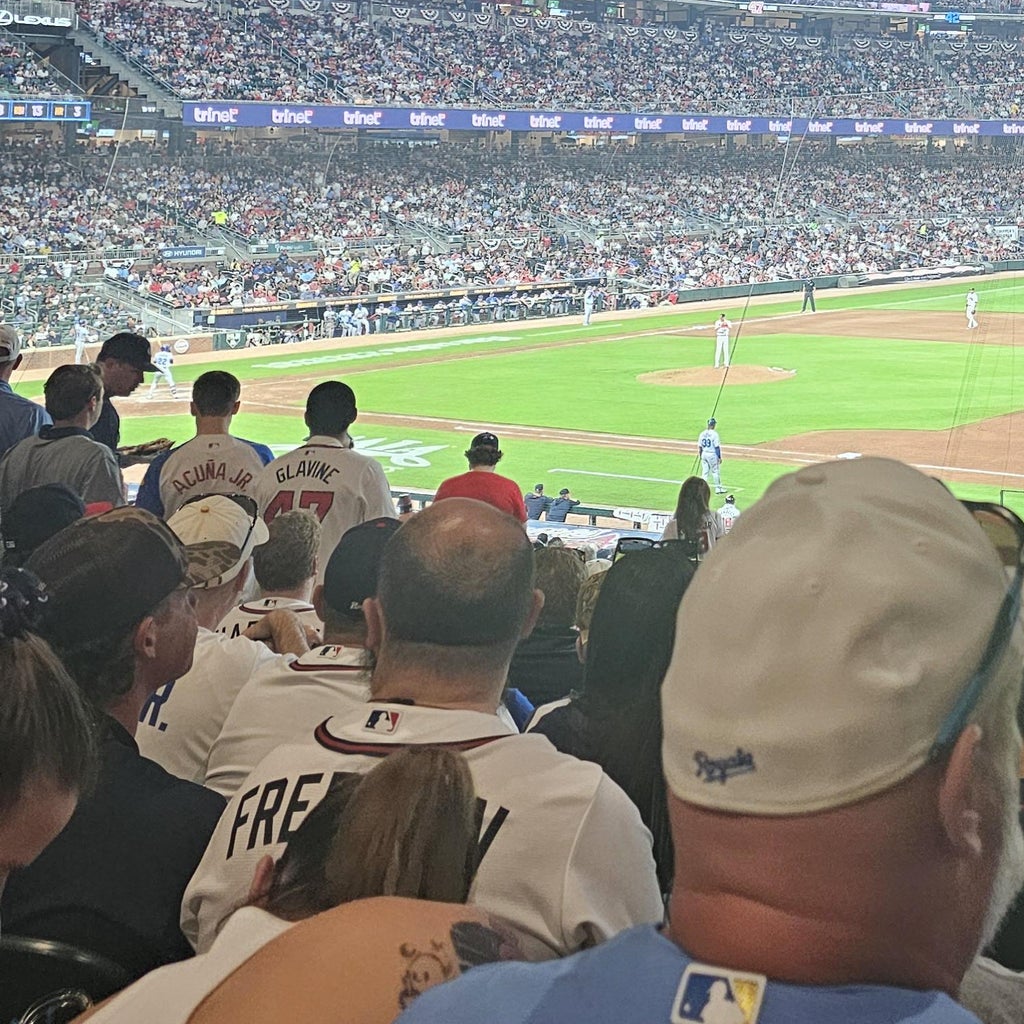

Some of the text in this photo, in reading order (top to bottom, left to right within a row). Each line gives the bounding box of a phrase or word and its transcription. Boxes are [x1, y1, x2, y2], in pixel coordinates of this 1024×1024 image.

[14, 15, 72, 27] LEXUS
[194, 107, 239, 123] trinet
[272, 108, 313, 124] trinet
[343, 110, 382, 126] trinet
[410, 112, 446, 127] trinet
[472, 114, 506, 128] trinet
[529, 115, 562, 128] trinet
[583, 116, 614, 129] trinet
[634, 117, 663, 130] trinet
[682, 119, 708, 131] trinet
[726, 119, 751, 131] trinet
[808, 121, 833, 132] trinet
[854, 121, 884, 133] trinet
[904, 122, 933, 133] trinet
[953, 123, 980, 134] trinet
[171, 459, 253, 495] ACUÑA JR.
[276, 460, 340, 486] GLAVINE
